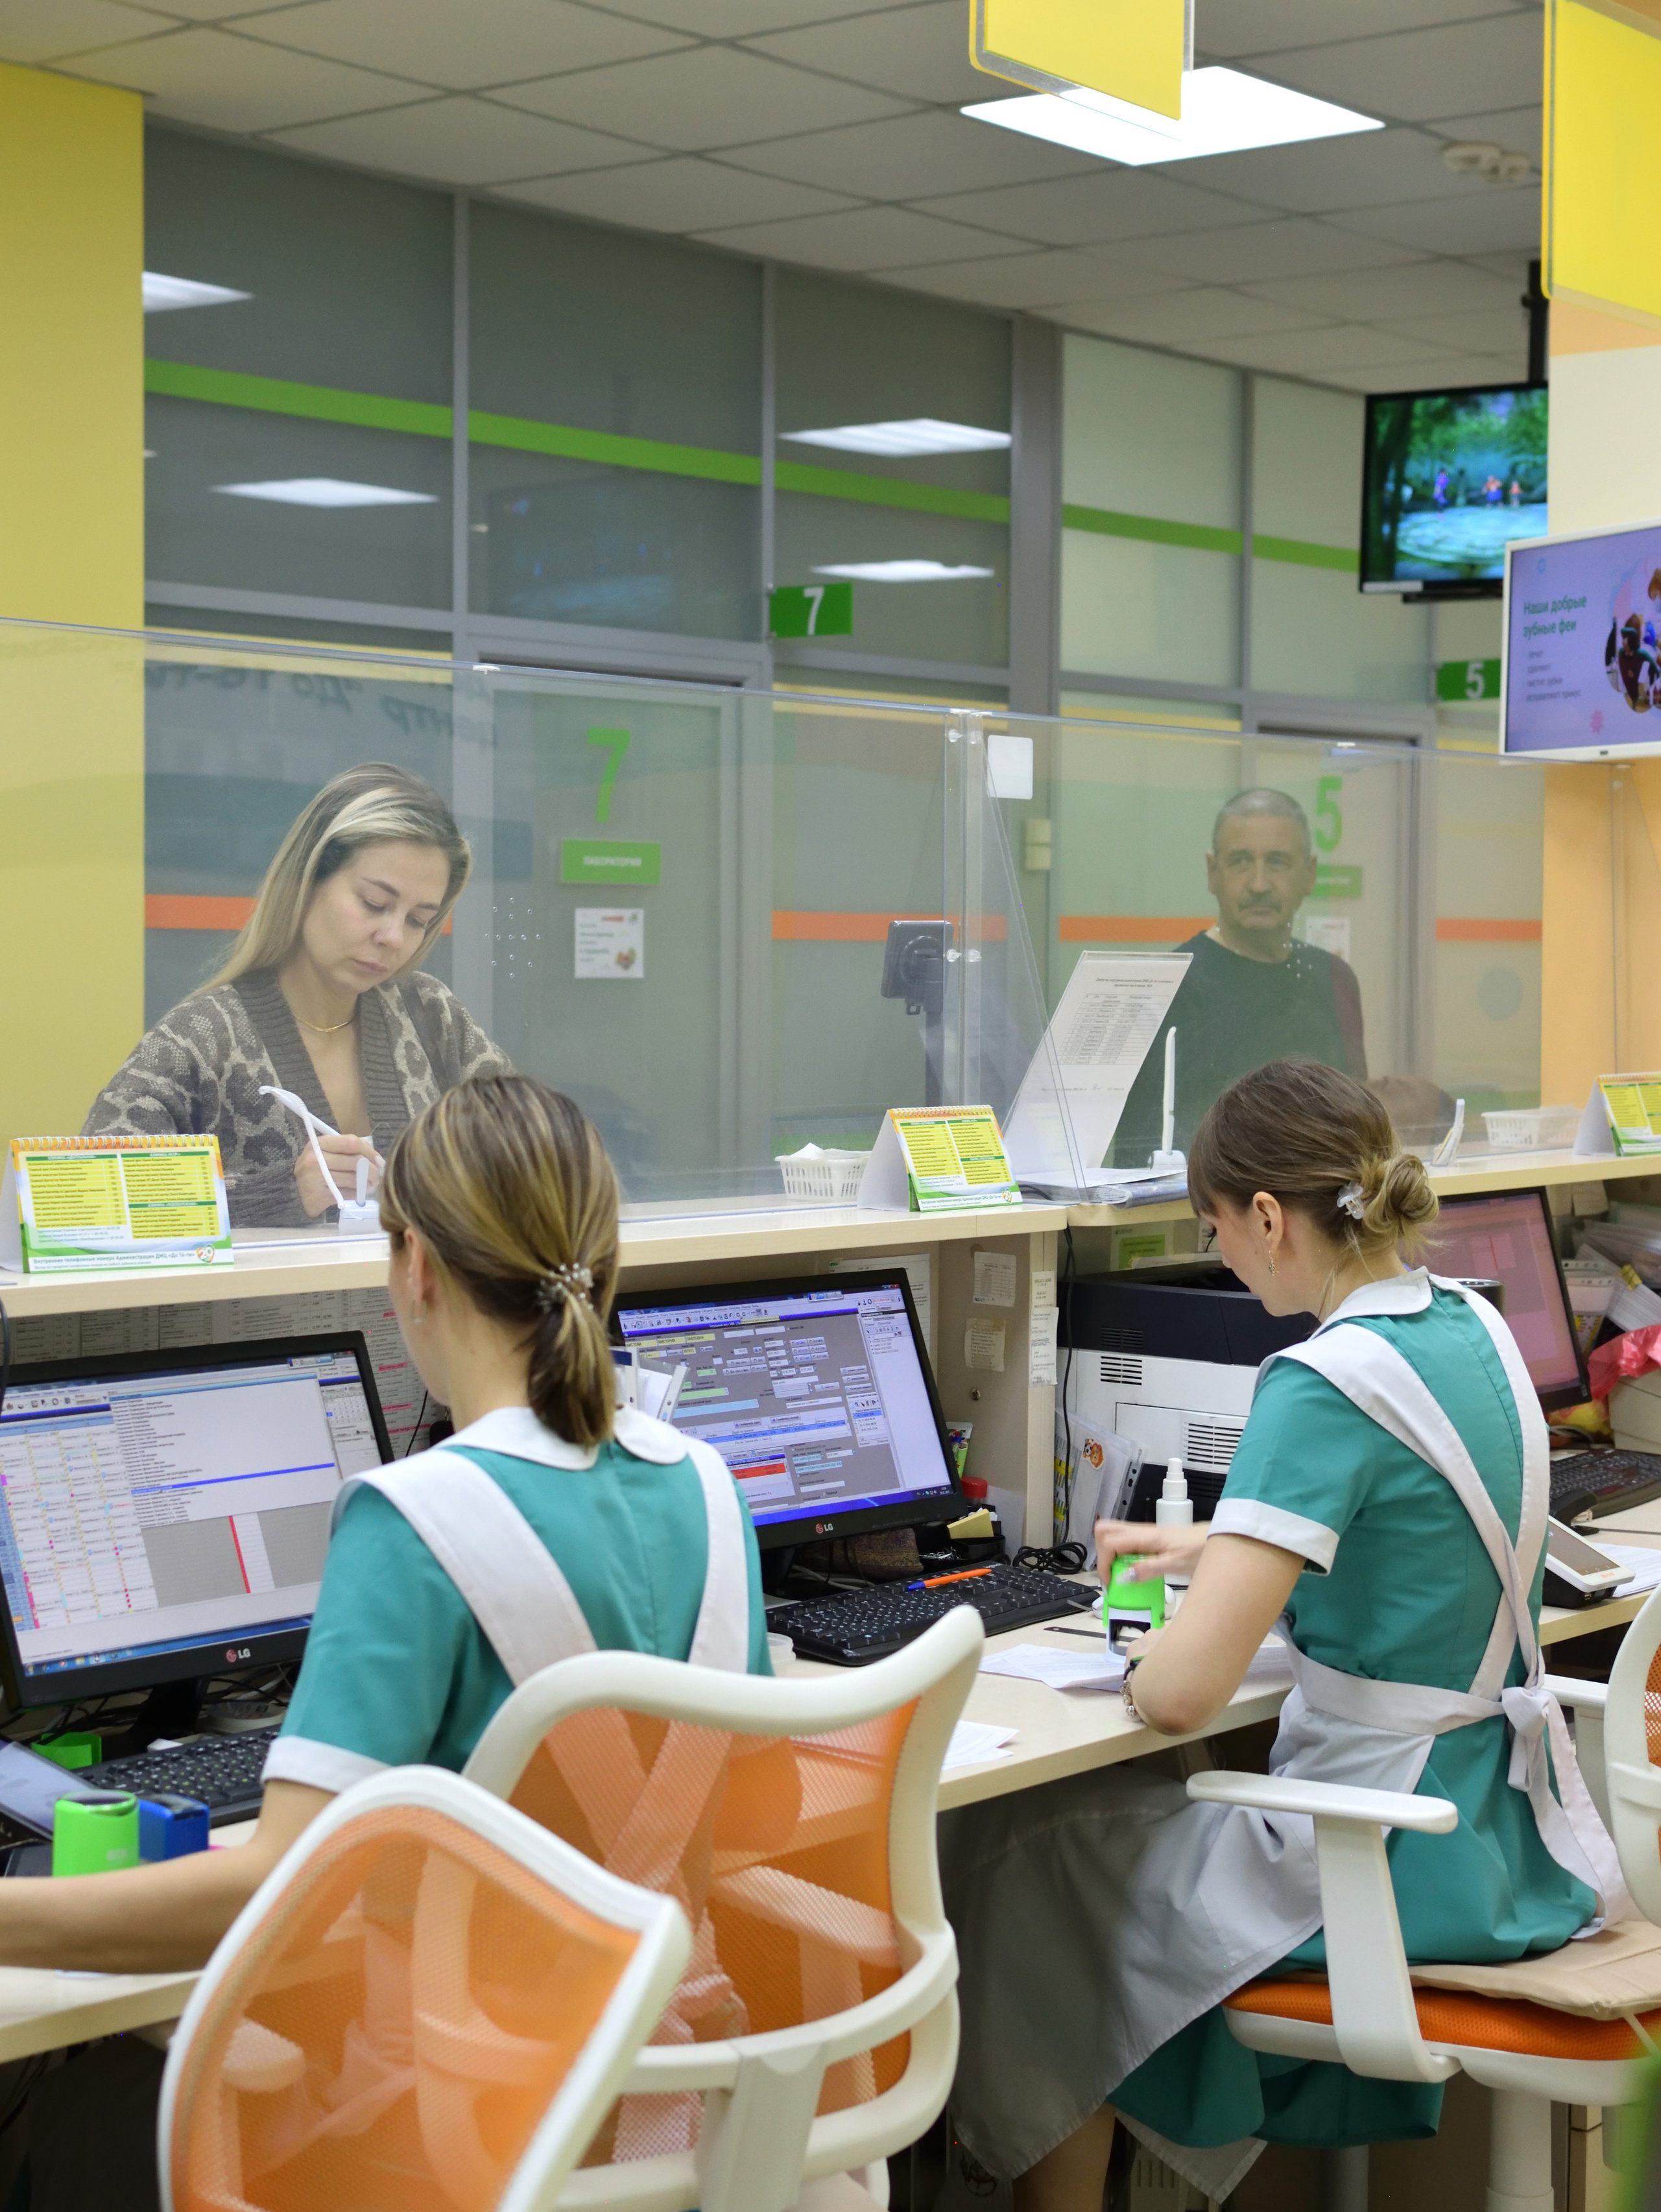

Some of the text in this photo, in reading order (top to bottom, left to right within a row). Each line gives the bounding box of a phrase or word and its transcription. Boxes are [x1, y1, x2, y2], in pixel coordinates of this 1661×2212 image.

[804, 587, 824, 636] 7
[1524, 595, 1587, 615] Наши добрые
[1524, 619, 1576, 641] зубные феи
[1466, 661, 1485, 700] 5
[587, 727, 631, 824] 7
[1314, 776, 1342, 852] 5
[824, 1523, 833, 1532] LG
[237, 1648, 251, 1659] LG
